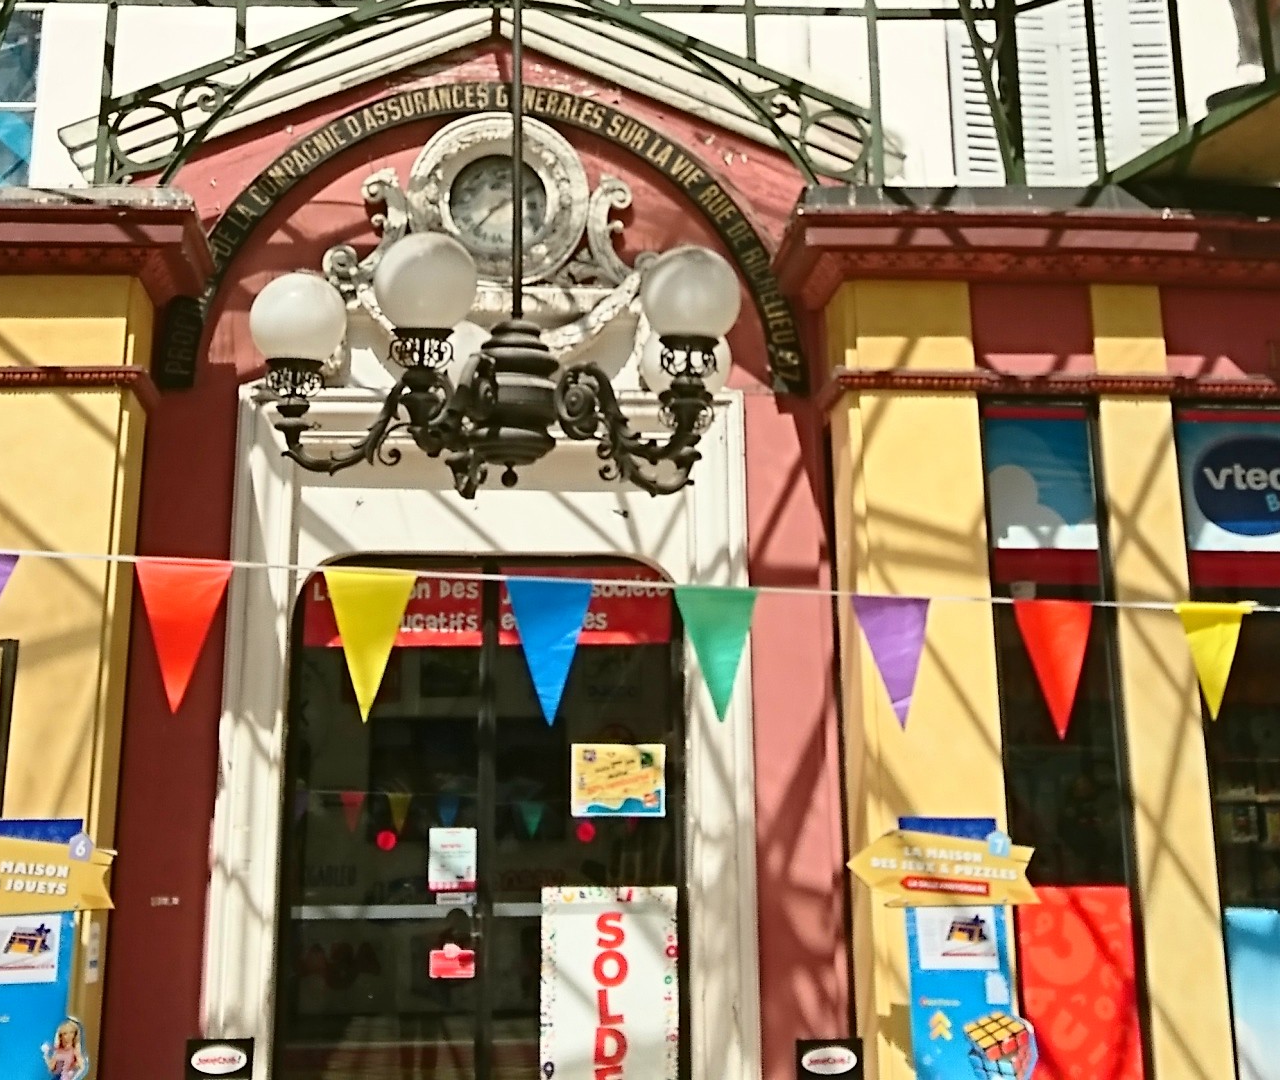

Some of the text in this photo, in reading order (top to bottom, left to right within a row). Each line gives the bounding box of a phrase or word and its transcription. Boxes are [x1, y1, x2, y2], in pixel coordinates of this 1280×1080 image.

[213, 227, 240, 257] DE
[229, 200, 261, 231] LA
[250, 124, 350, 206] COMPAGNIE
[495, 84, 607, 130] GNERALES
[607, 115, 649, 150] SUR
[646, 136, 676, 168] LA
[670, 152, 703, 191] VIE
[698, 182, 736, 224] RUE
[726, 220, 756, 251] DE
[75, 840, 86, 857] 6
[903, 846, 983, 862] LA MAISON
[0, 860, 69, 879] MAISON
[4, 879, 68, 896] JOUETS
